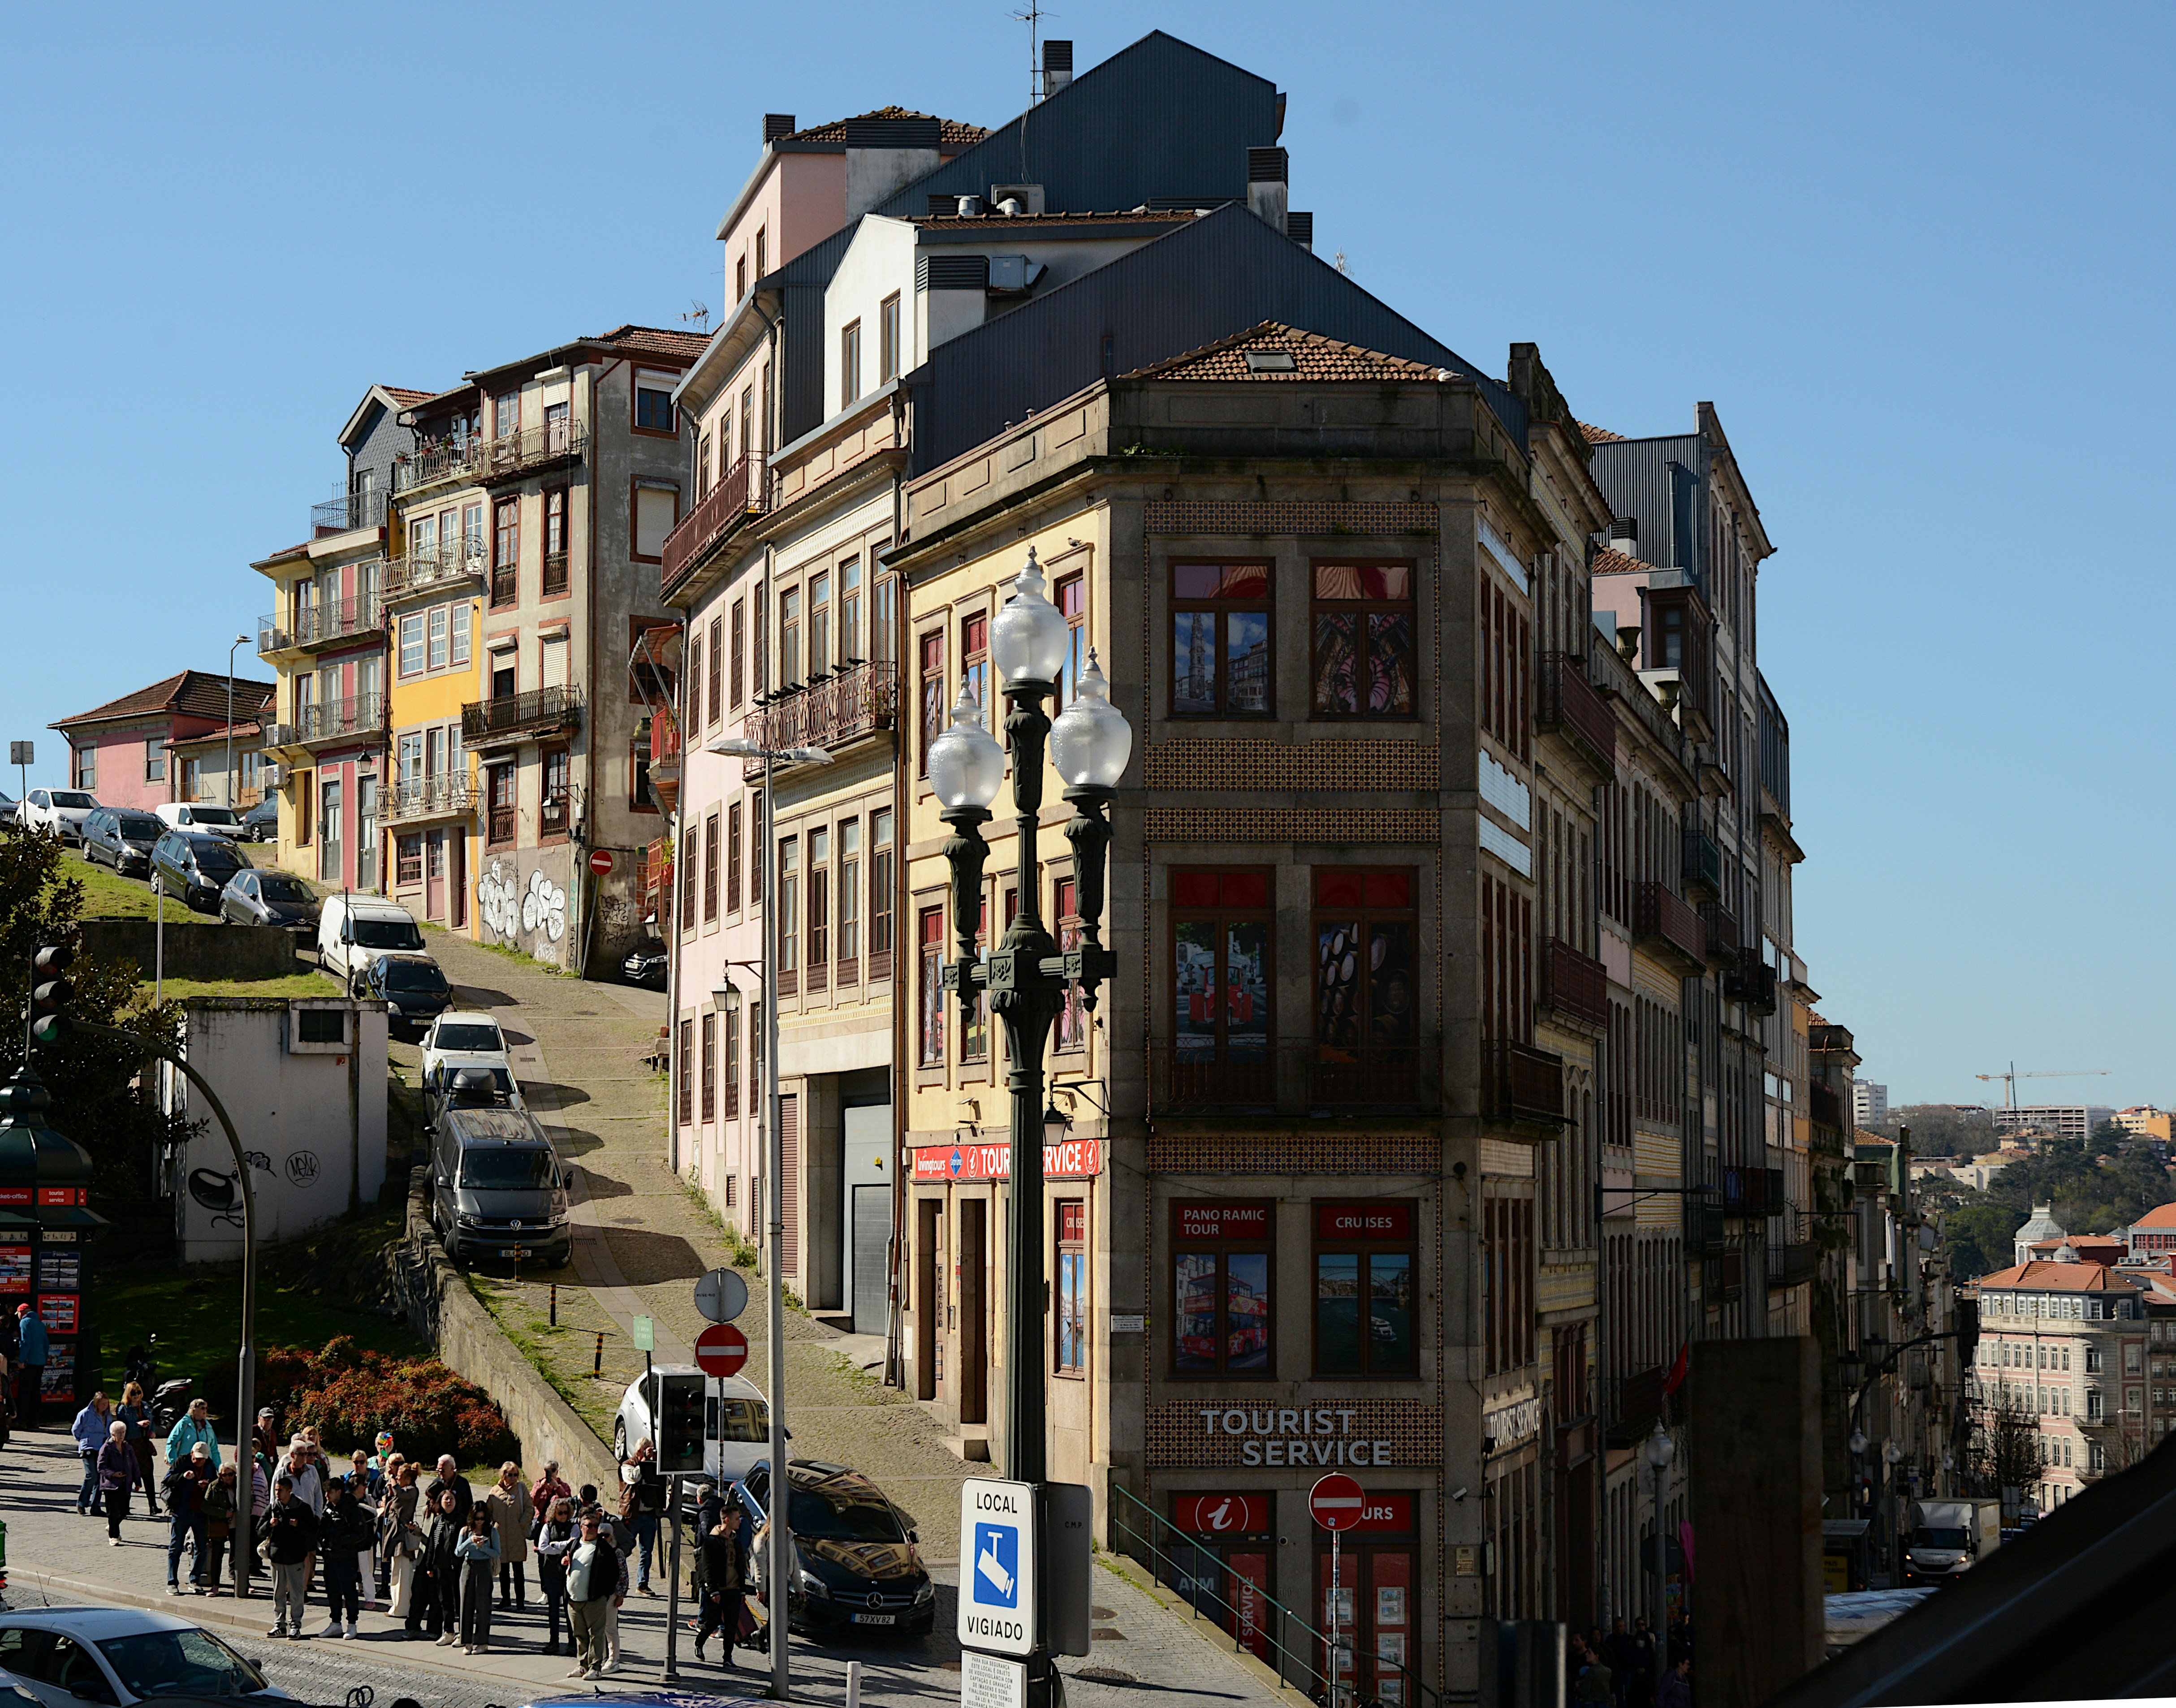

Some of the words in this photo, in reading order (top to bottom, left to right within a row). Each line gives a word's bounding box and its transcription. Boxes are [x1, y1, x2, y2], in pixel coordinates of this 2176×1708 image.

[918, 1157, 946, 1174] livingtours
[981, 1147, 1010, 1175] TOUR
[1043, 1143, 1081, 1173] RVICE
[1183, 1224, 1219, 1235] TOUR
[1335, 1216, 1393, 1228] CRUISES
[1200, 1410, 1356, 1434] TOURIST
[1490, 1407, 1515, 1449] TOURIST
[1517, 1397, 1539, 1439] SERVICE
[1243, 1440, 1390, 1466] SERVICE
[977, 1492, 1018, 1514] LOCAL
[1362, 1507, 1394, 1520] URS
[1065, 1521, 1084, 1529] C.M.P.
[967, 1616, 1023, 1640] VIGIADO
[989, 1661, 1010, 1670] SEGURANÇA
[970, 1675, 988, 1684] CAPTAÇÃO
[993, 1681, 1011, 1690] GRAVAÇÃO
[974, 1670, 1004, 1682] VIDEOVIGILÂNCIA
[969, 1687, 989, 1697] FINALIDADE
[998, 1695, 1012, 1703] TERMOS
[978, 1683, 994, 1692] IMAGENS
[967, 1699, 988, 1708] SEGURANÇA
